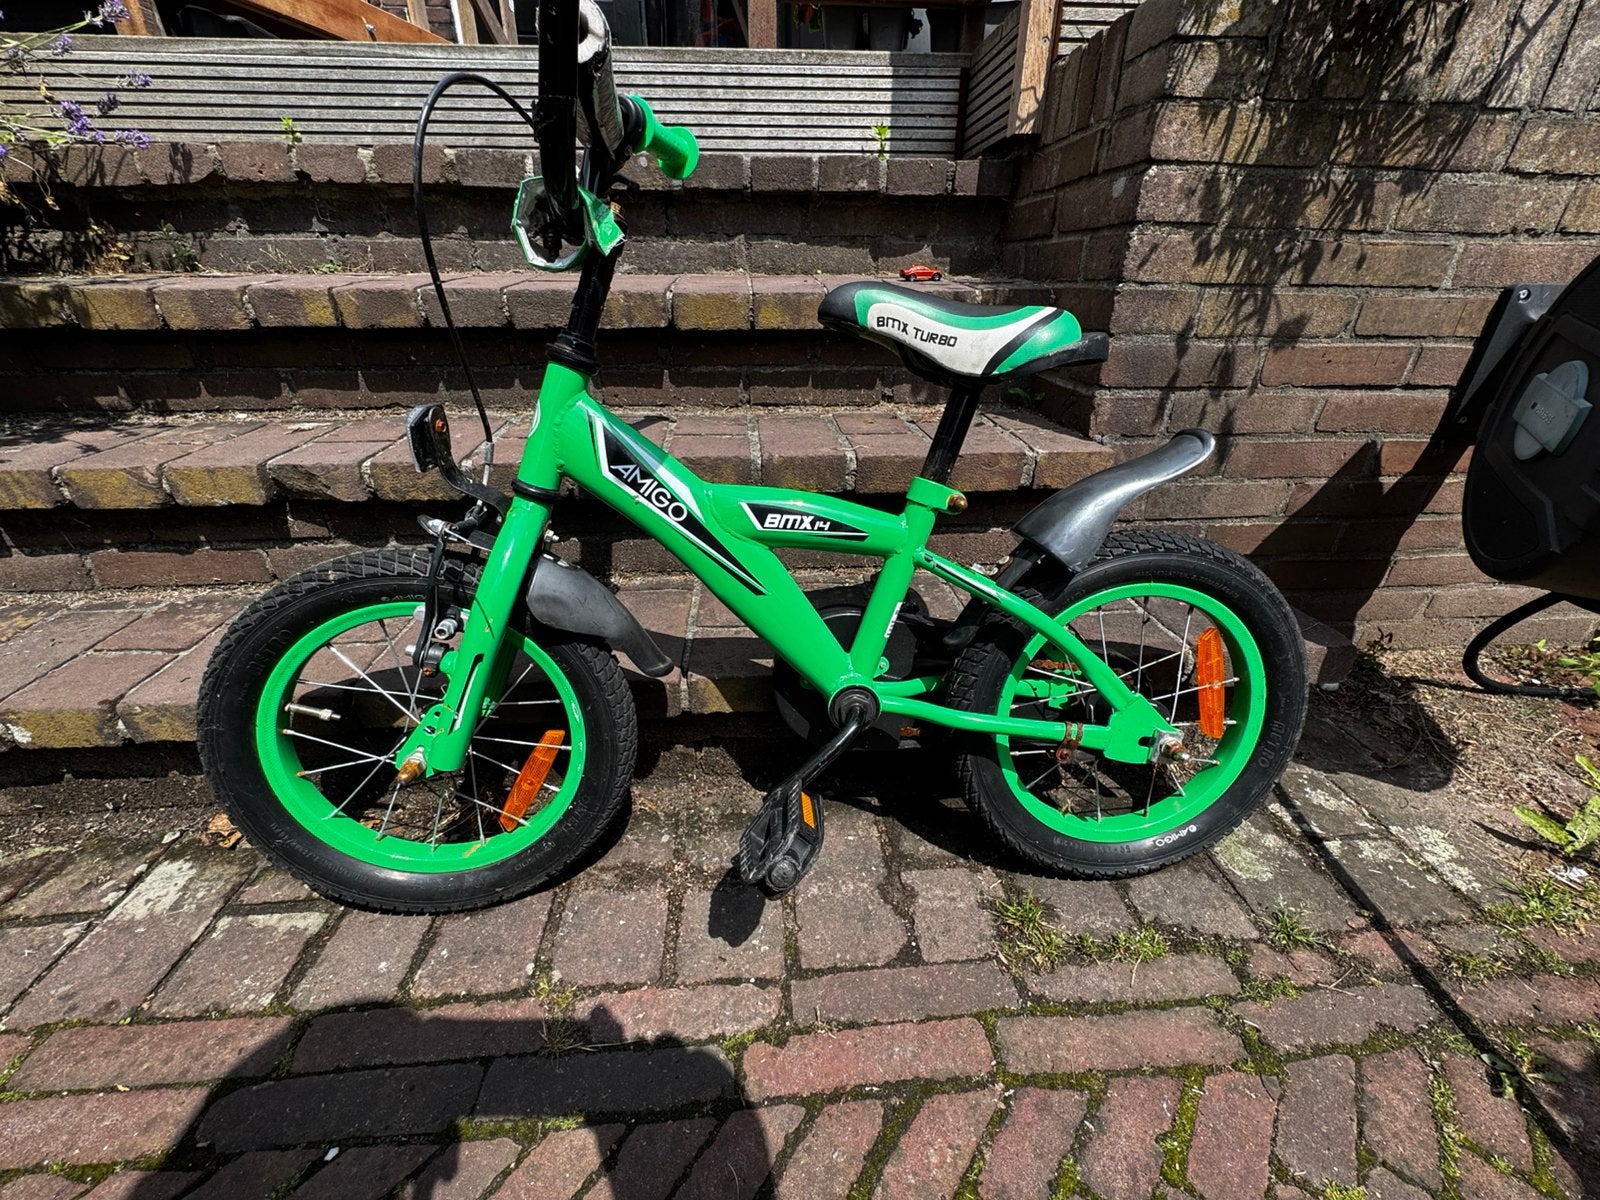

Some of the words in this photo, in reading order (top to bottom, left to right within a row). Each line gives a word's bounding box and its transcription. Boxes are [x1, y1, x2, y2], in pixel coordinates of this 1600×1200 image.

[876, 316, 909, 335] BMX
[913, 326, 958, 348] TURBO
[610, 463, 688, 522] AMIGO
[763, 513, 814, 530] BMX
[813, 519, 831, 531] 14
[1155, 826, 1189, 846] AMIGO
